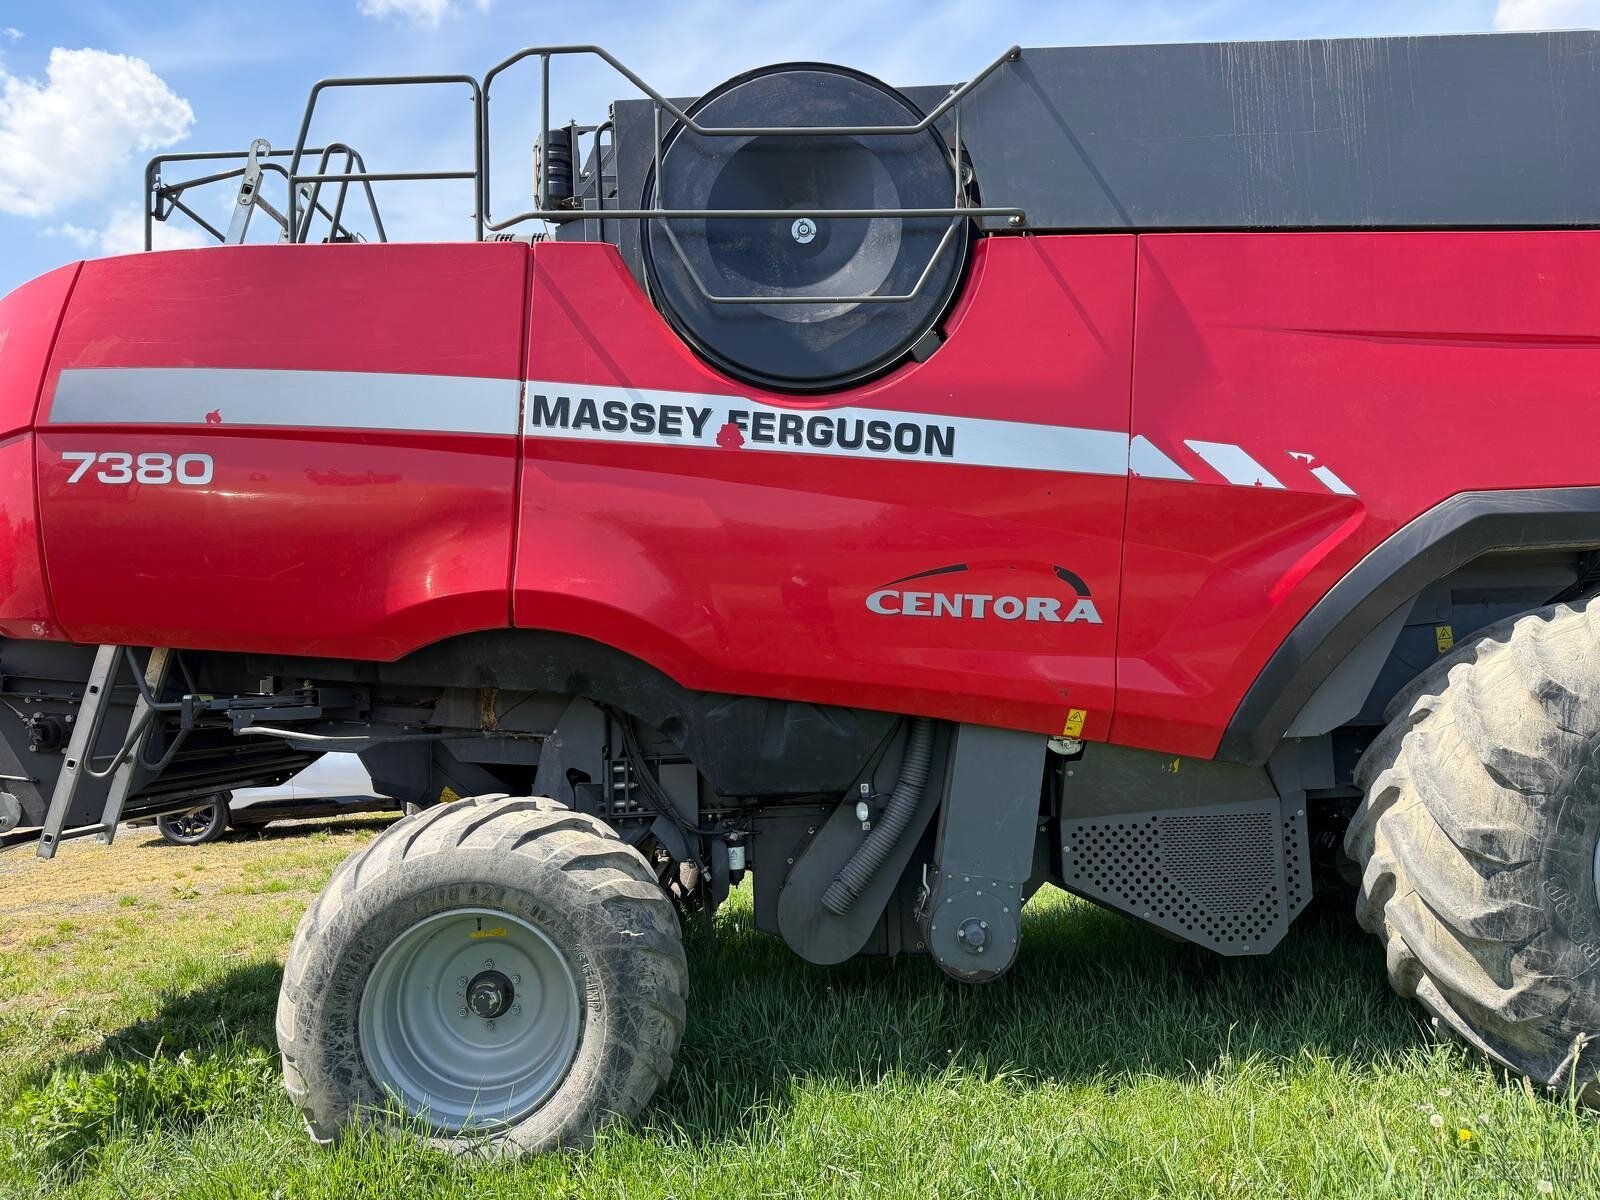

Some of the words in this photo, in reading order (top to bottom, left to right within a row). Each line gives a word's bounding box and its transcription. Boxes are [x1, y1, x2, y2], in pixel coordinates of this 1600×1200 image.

[532, 395, 712, 437] MASSEY
[728, 410, 955, 458] FERGUSON
[62, 452, 214, 485] 7380
[865, 589, 1104, 624] CENTORA
